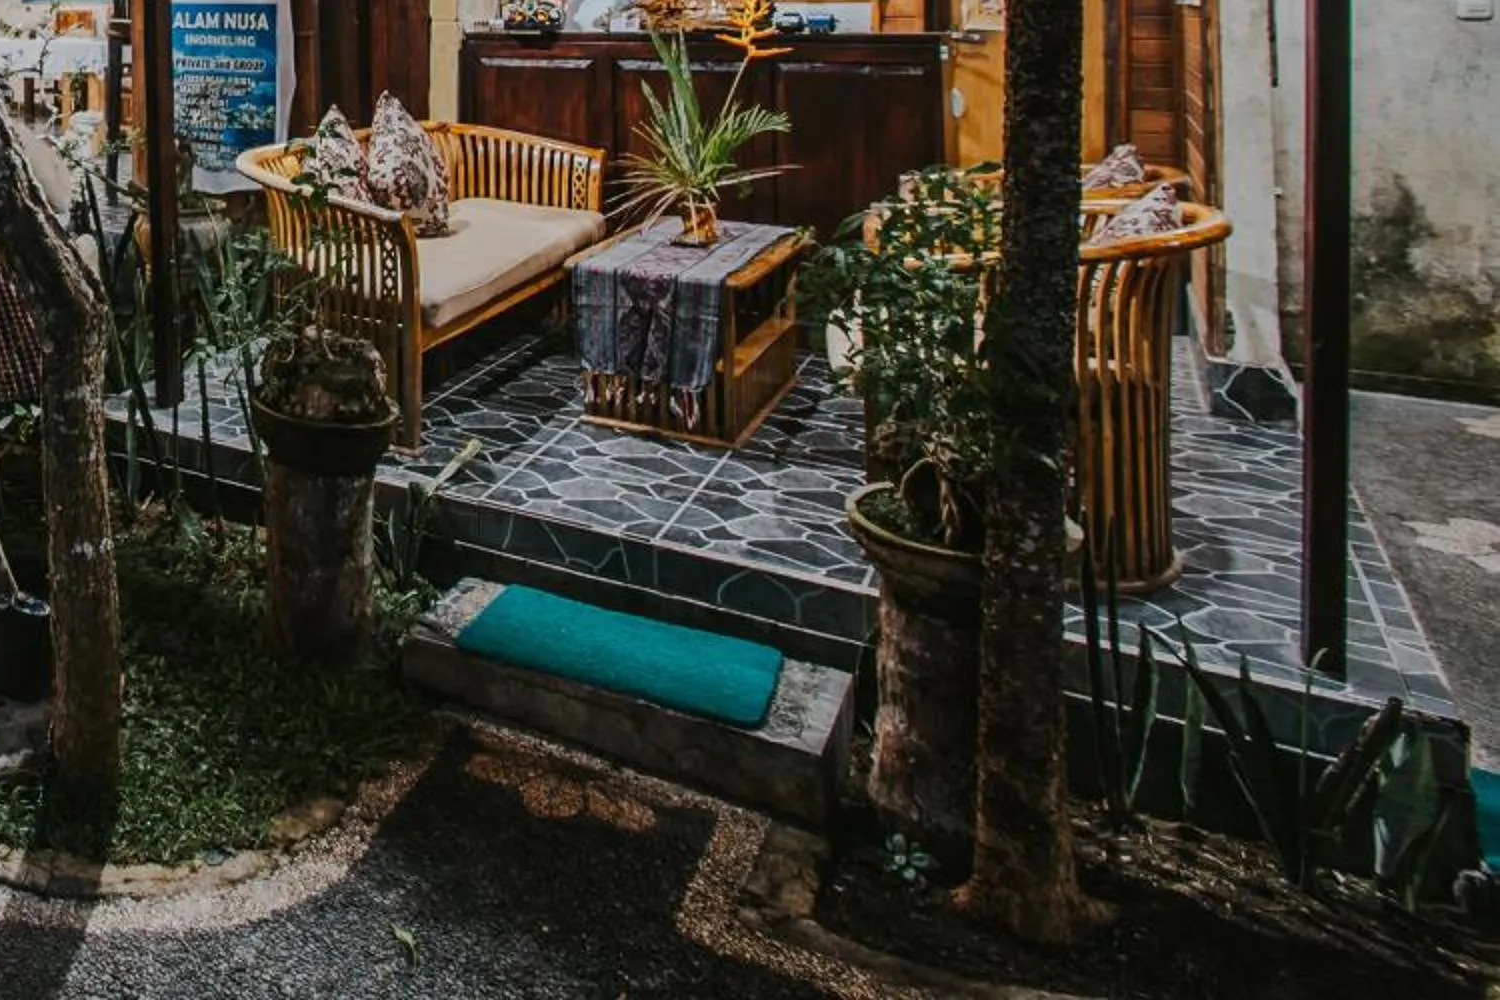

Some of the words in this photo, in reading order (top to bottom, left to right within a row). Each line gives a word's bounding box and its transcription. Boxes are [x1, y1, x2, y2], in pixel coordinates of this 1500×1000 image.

[173, 11, 219, 29] ALAM
[223, 11, 269, 31] NUSA
[175, 57, 212, 69] PRIVATE
